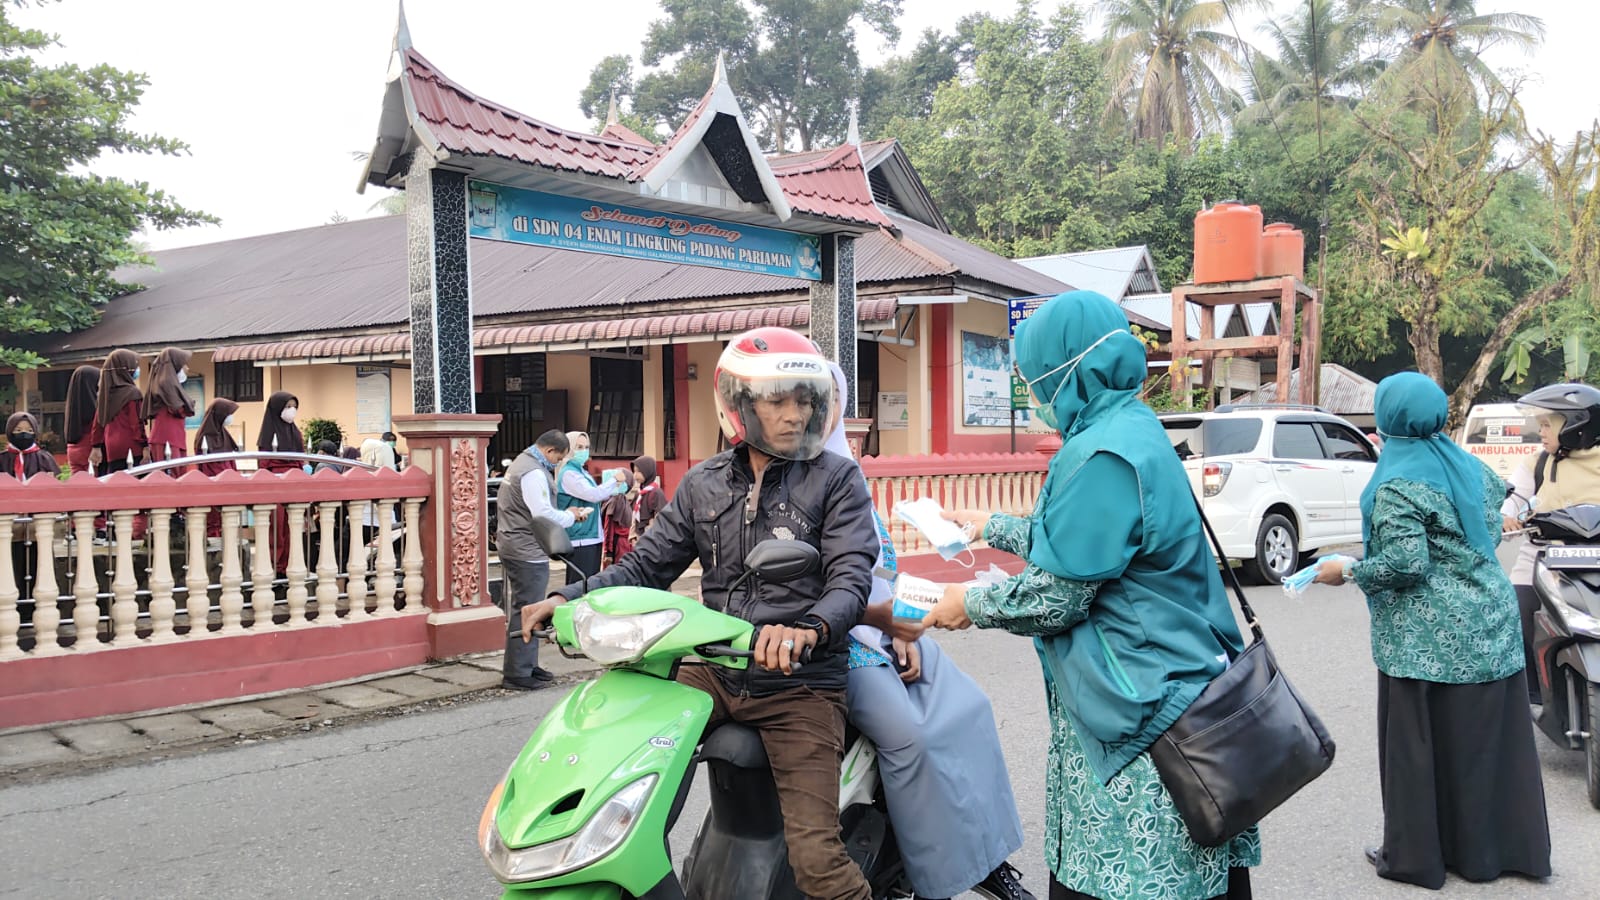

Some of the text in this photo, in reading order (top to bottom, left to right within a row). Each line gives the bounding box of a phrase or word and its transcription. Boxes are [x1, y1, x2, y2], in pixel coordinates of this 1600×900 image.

[582, 206, 742, 242] Selamat Datang
[513, 216, 792, 268] di SDN 04 ENAM LINGKUNG PADANG PARIAMAN
[1011, 309, 1036, 319] SD NE
[1471, 446, 1538, 455] AMBULANCE
[901, 592, 941, 605] FACEMA
